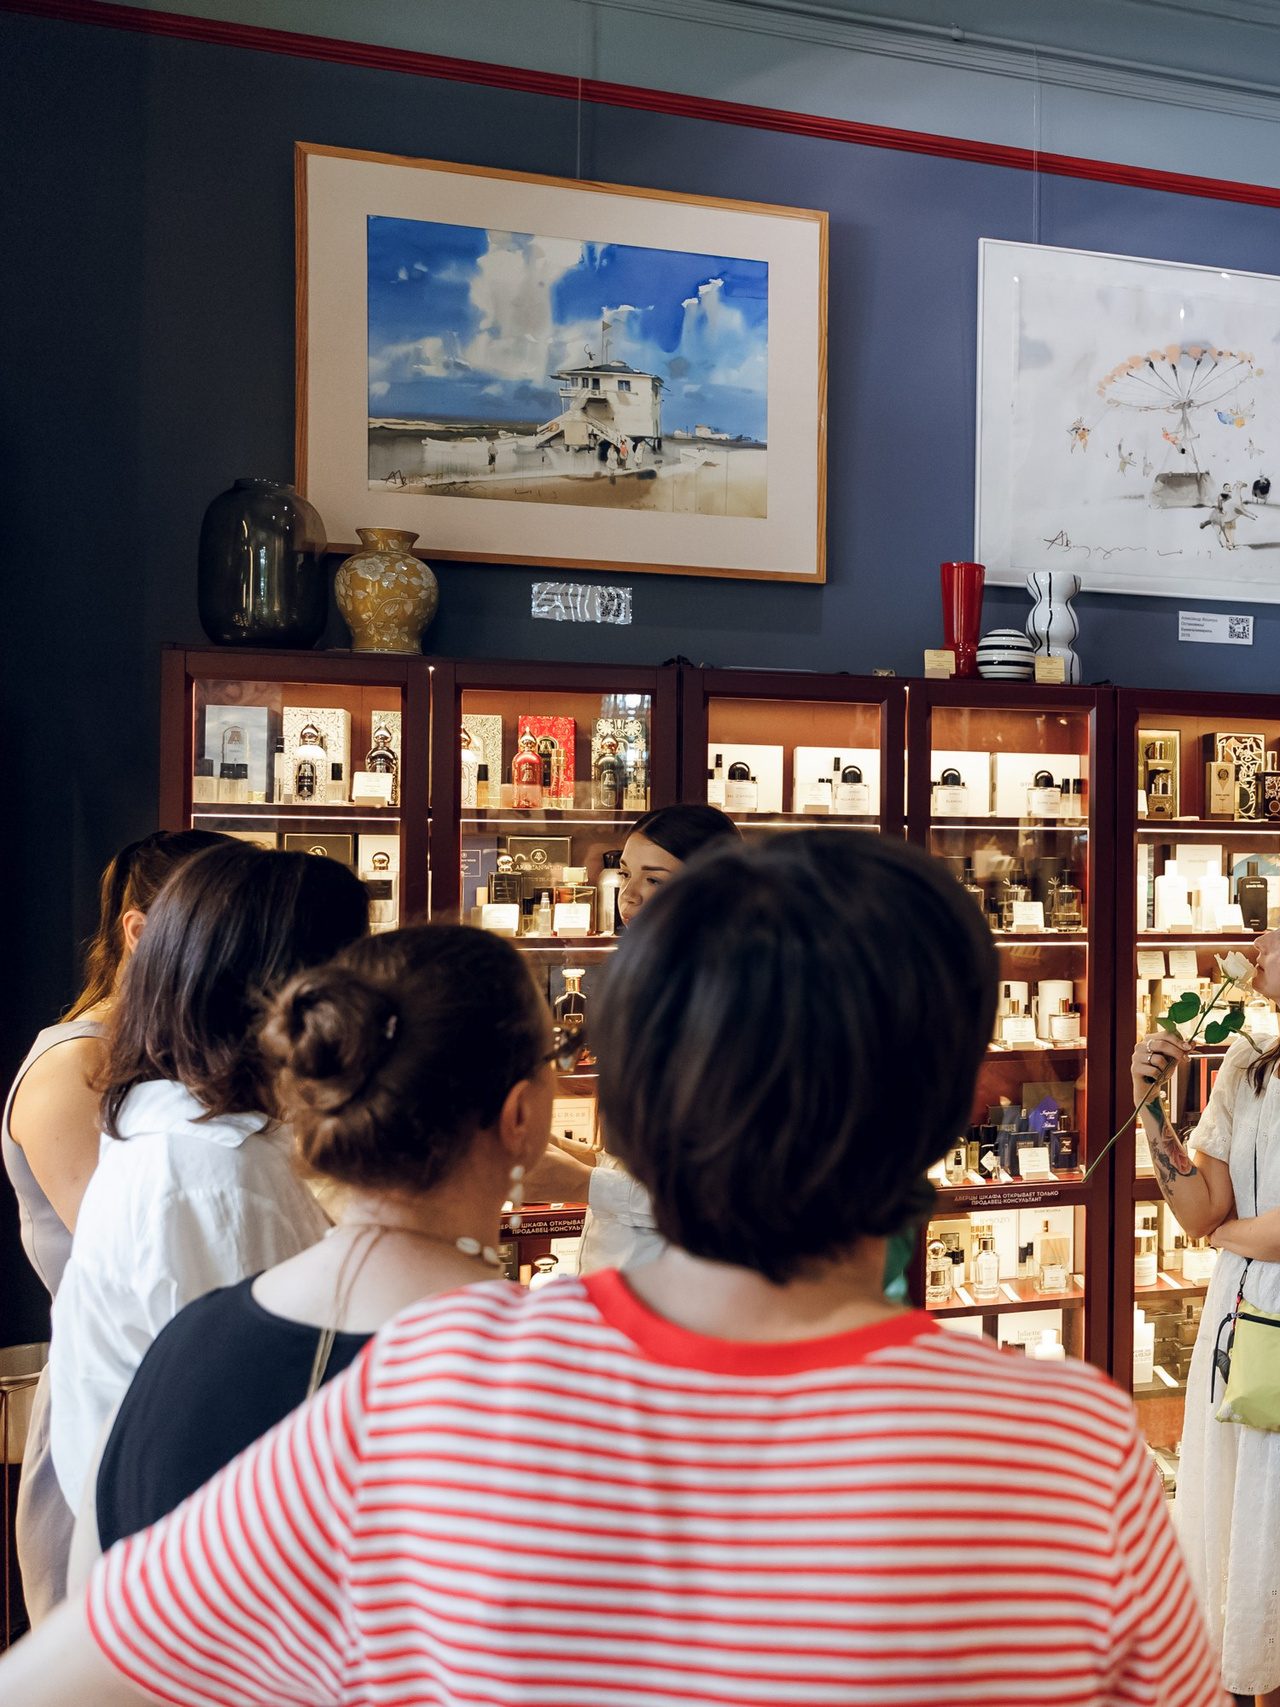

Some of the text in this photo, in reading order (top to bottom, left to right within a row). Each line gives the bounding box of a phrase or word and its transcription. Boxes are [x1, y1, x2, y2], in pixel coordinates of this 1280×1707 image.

[1002, 1191, 1036, 1199] ОТКРЫВАЕТ
[521, 1221, 548, 1229] ШКАФА
[549, 1218, 585, 1227] ОТКРЫВАЕ
